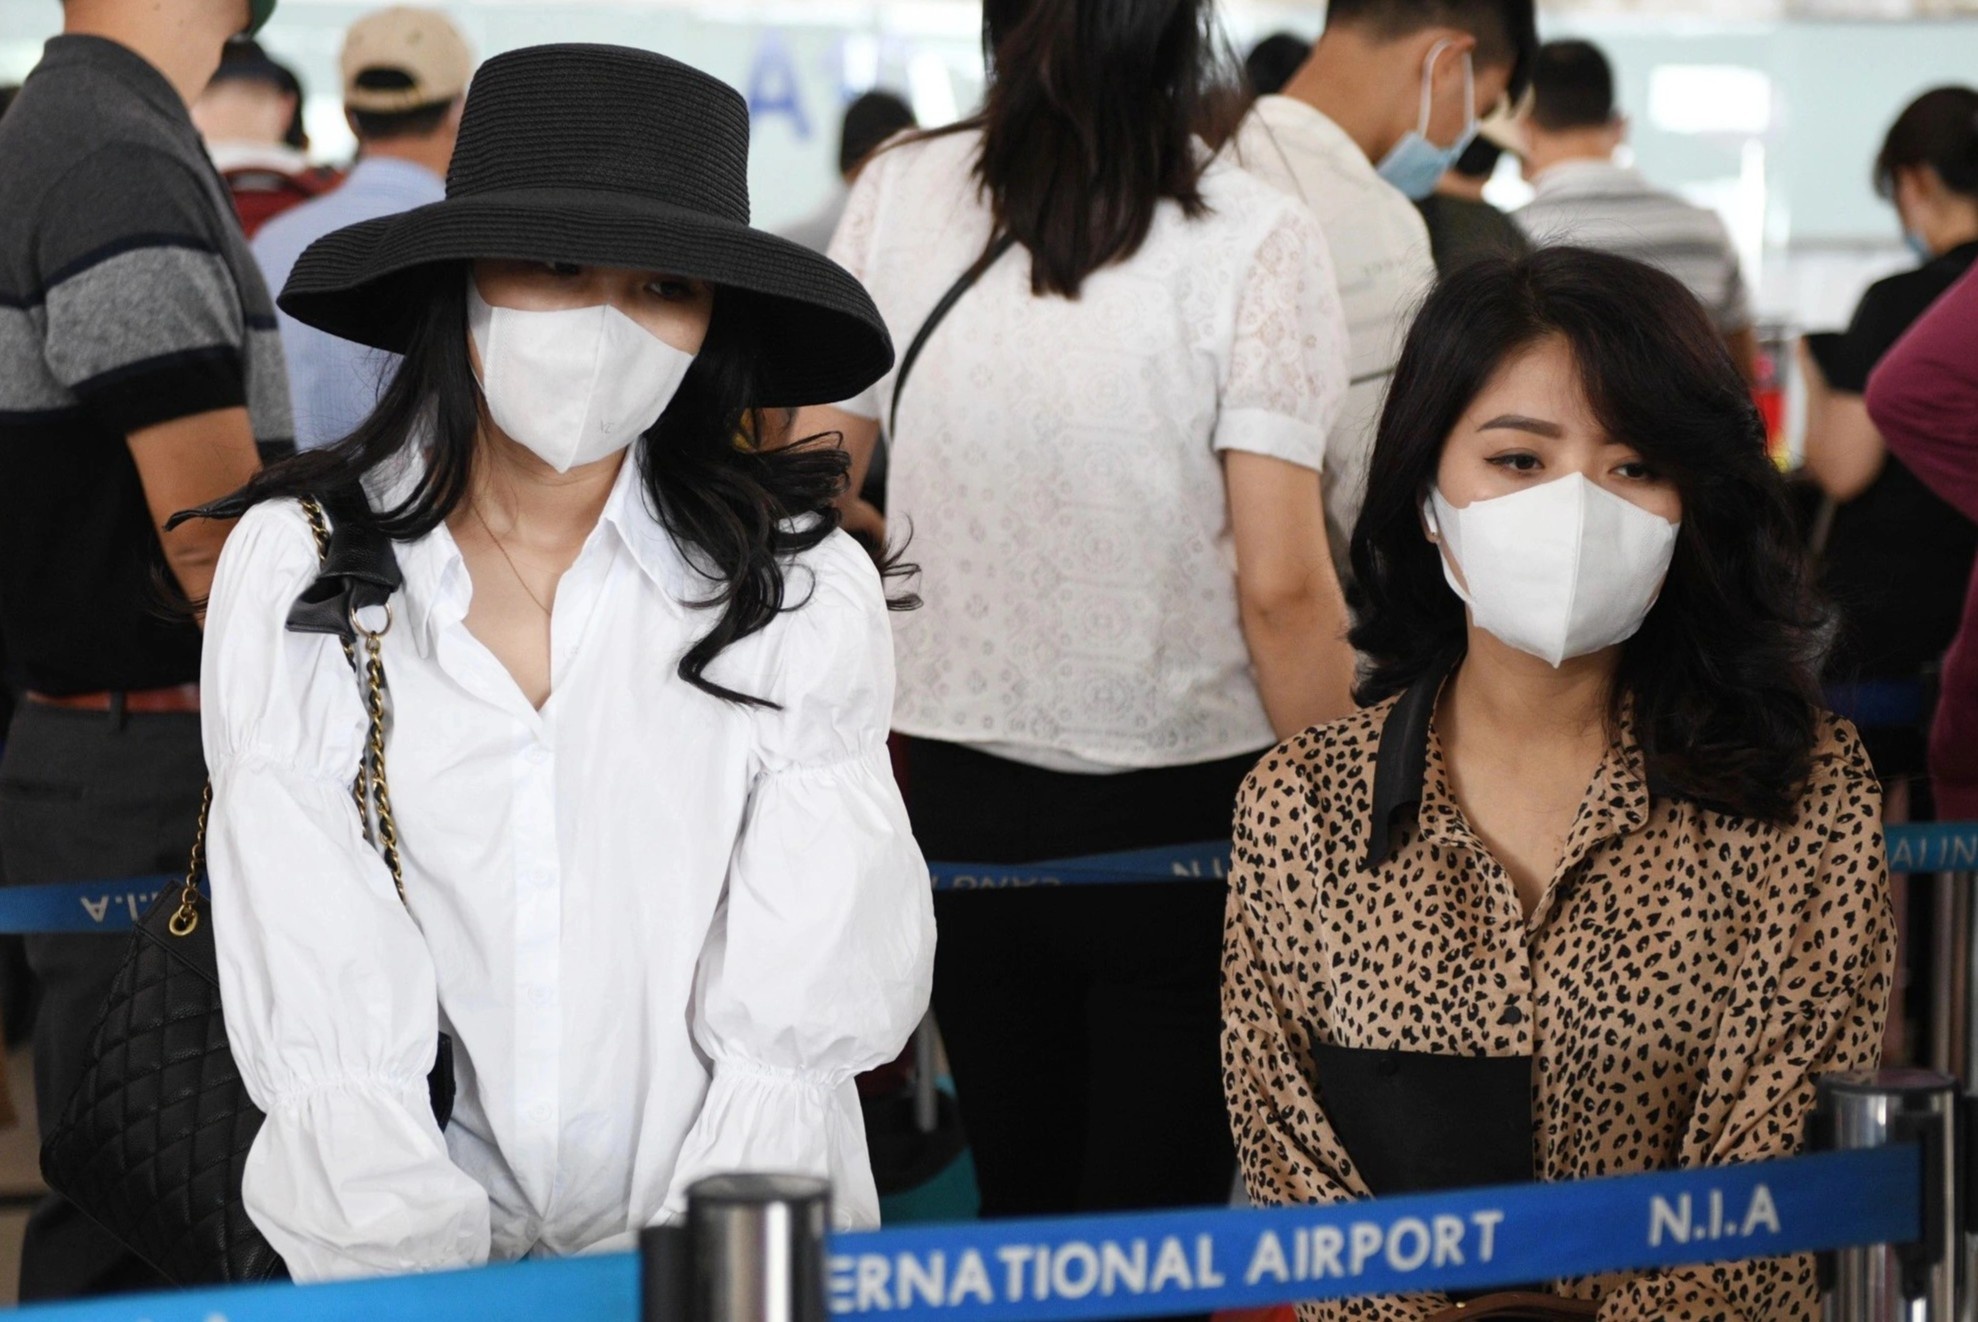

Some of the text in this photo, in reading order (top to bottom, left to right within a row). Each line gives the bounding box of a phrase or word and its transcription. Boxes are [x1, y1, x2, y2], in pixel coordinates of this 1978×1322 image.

[80, 892, 158, 922] .I.A
[1245, 1211, 1504, 1286] AIRPORT
[1648, 1184, 1781, 1247] N.I.A
